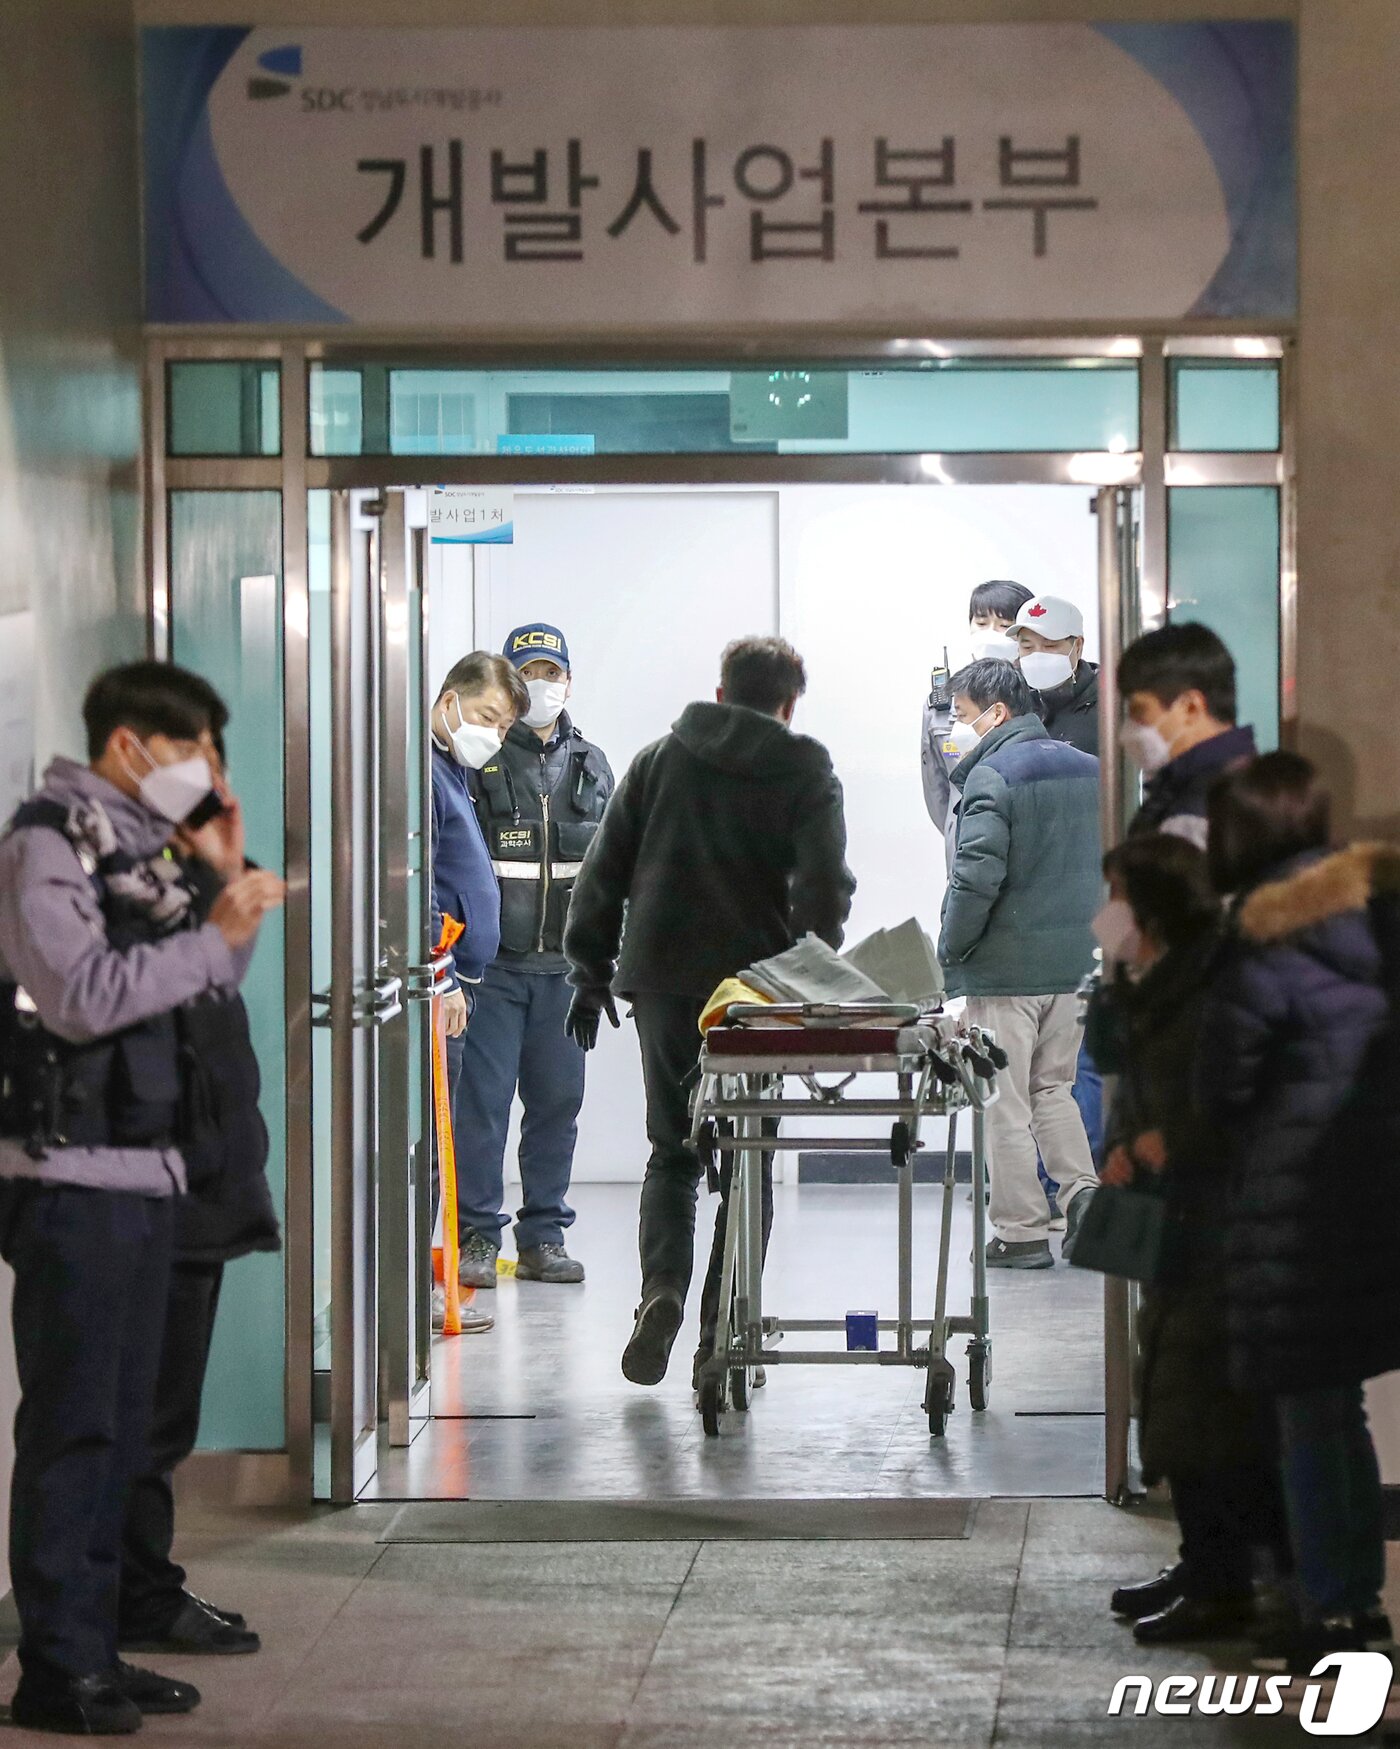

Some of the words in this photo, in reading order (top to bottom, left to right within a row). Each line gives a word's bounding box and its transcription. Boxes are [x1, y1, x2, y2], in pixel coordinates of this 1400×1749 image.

[301, 88, 353, 113] SDC
[355, 136, 1099, 266] 개발사업본부
[513, 632, 561, 649] KCSI
[500, 830, 531, 840] KCSI
[500, 839, 532, 848] 과학수사
